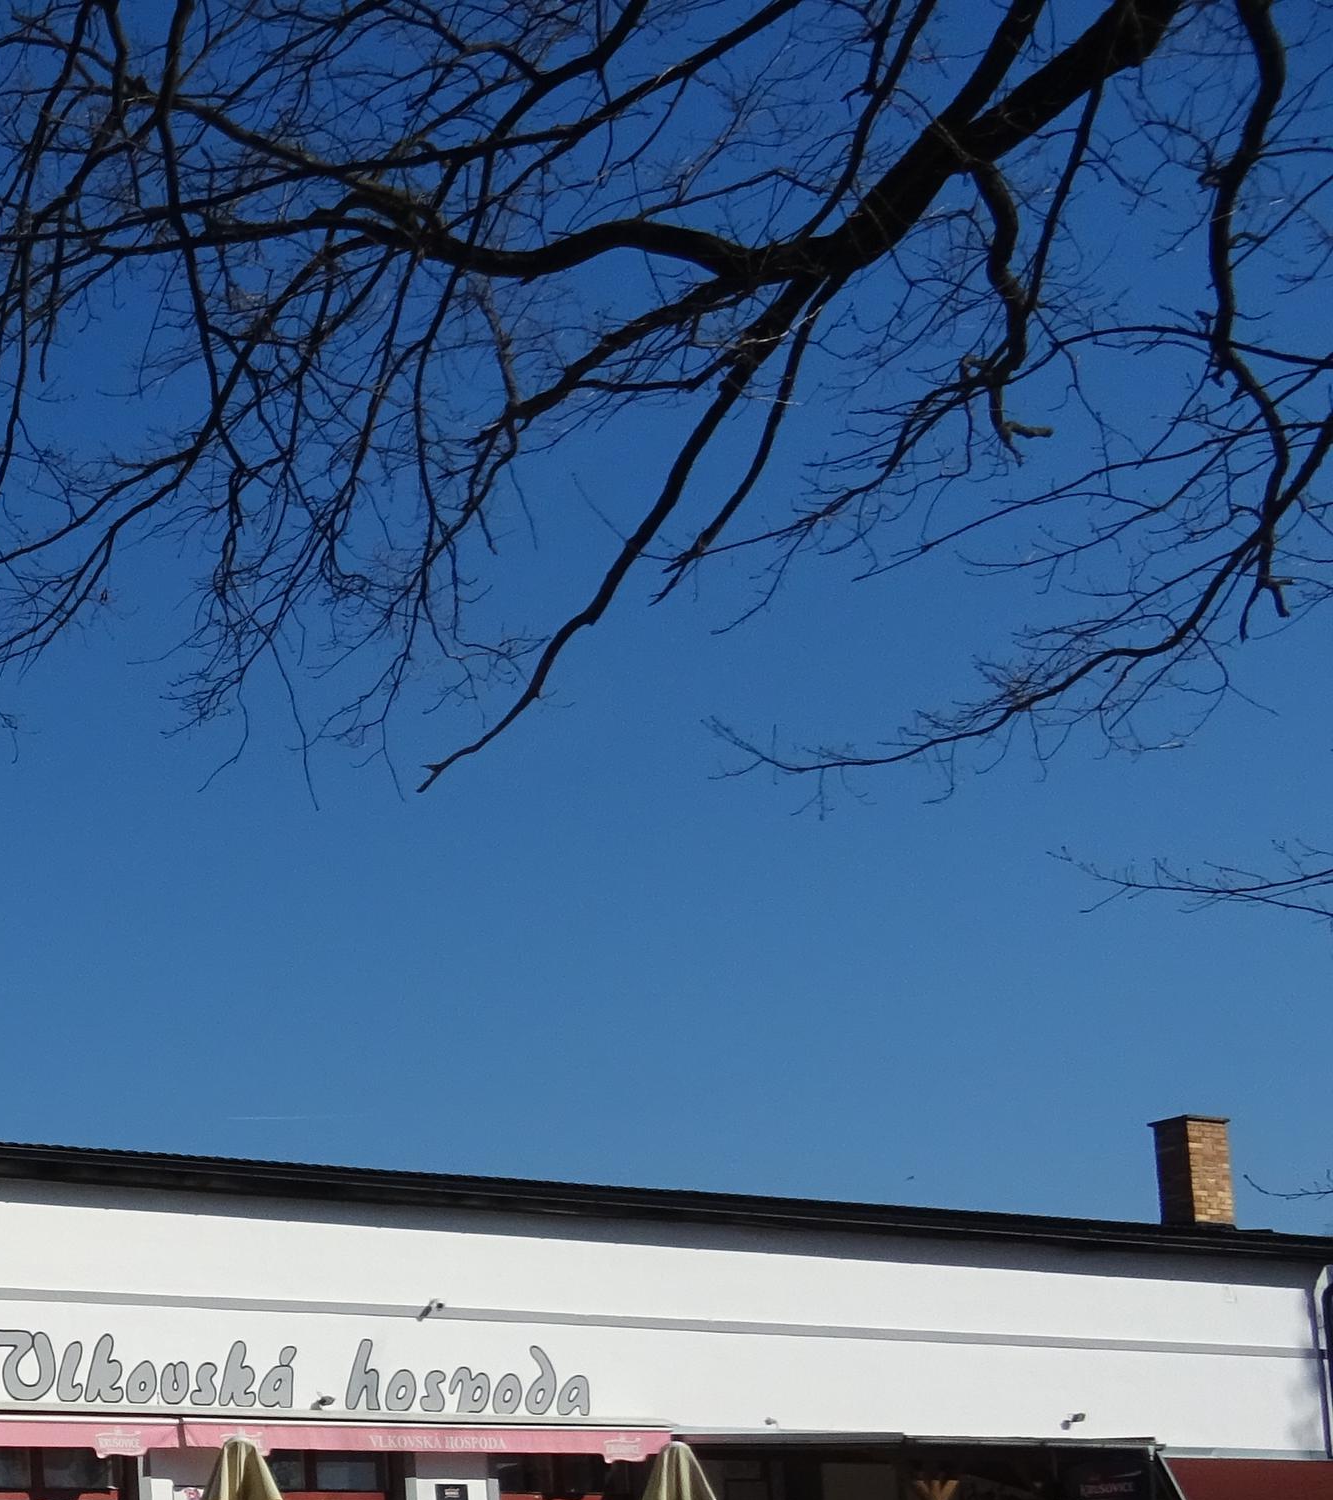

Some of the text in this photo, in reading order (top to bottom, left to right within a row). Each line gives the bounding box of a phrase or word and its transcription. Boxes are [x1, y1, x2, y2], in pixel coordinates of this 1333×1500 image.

[345, 1338, 591, 1416] hospoda
[369, 1433, 507, 1450] VLKOVSKÁ HOSPODA
